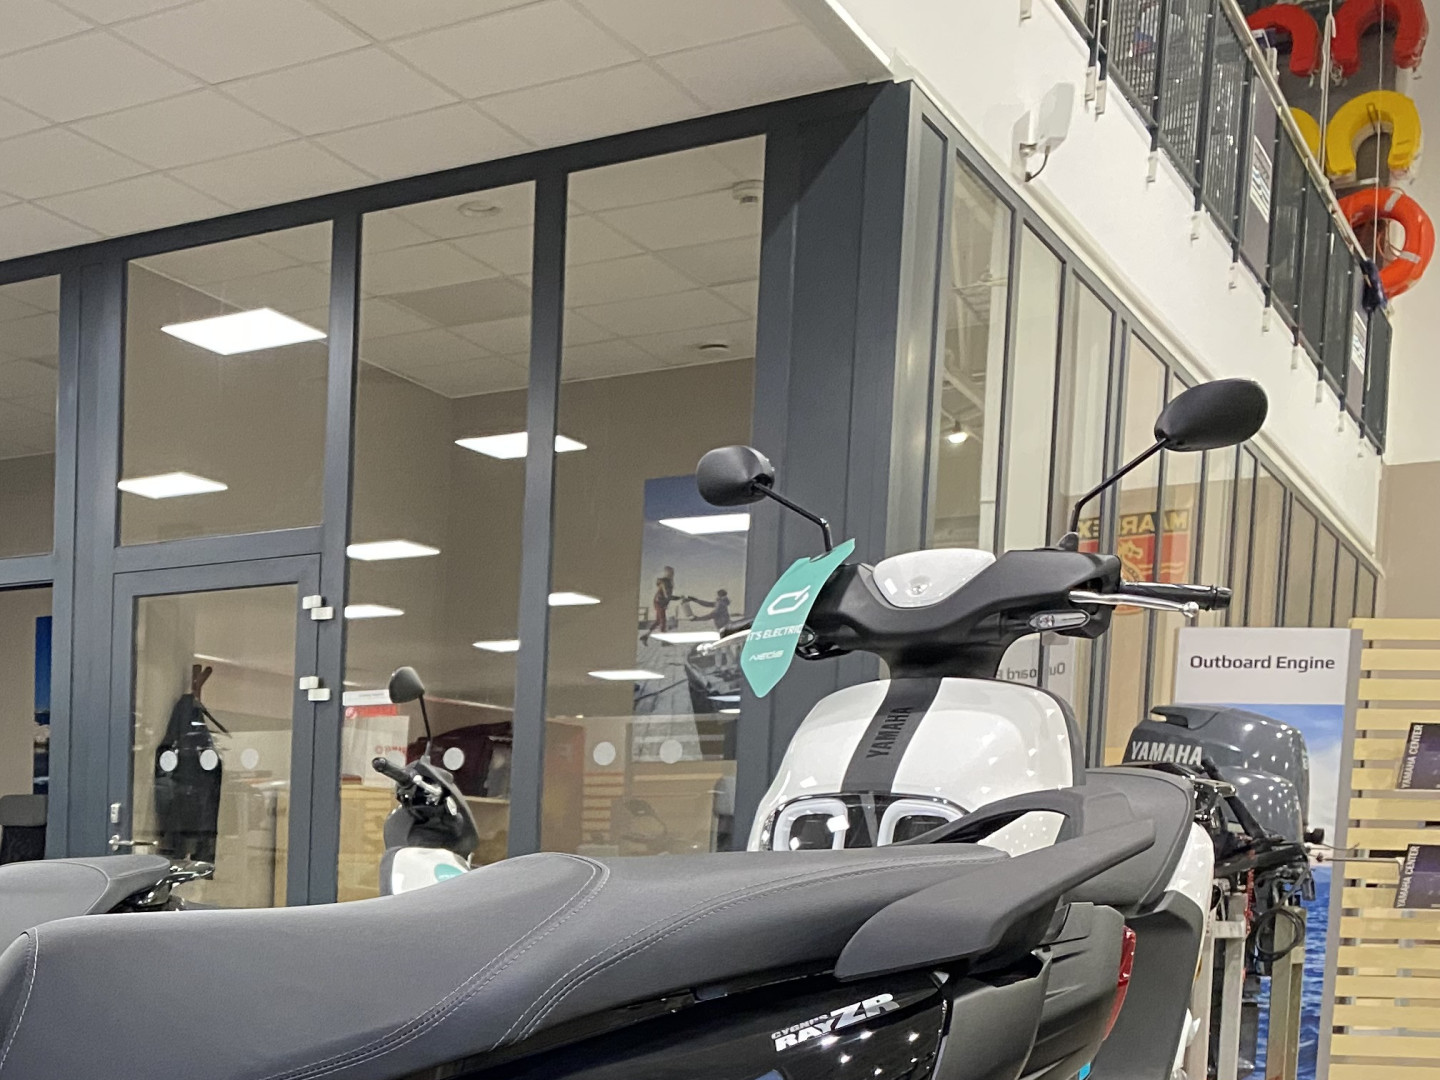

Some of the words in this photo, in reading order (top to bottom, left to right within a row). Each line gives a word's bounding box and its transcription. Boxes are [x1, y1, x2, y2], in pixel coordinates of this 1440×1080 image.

[1190, 655, 1271, 670] Outboard
[1276, 656, 1335, 672] Engine
[866, 707, 914, 758] YAMAHA
[1131, 740, 1203, 766] YAMAHA
[1402, 756, 1416, 789] YAMAHA
[1409, 724, 1423, 754] CENTER
[1396, 877, 1411, 908] YAMAHA
[1405, 846, 1420, 875] CENTER
